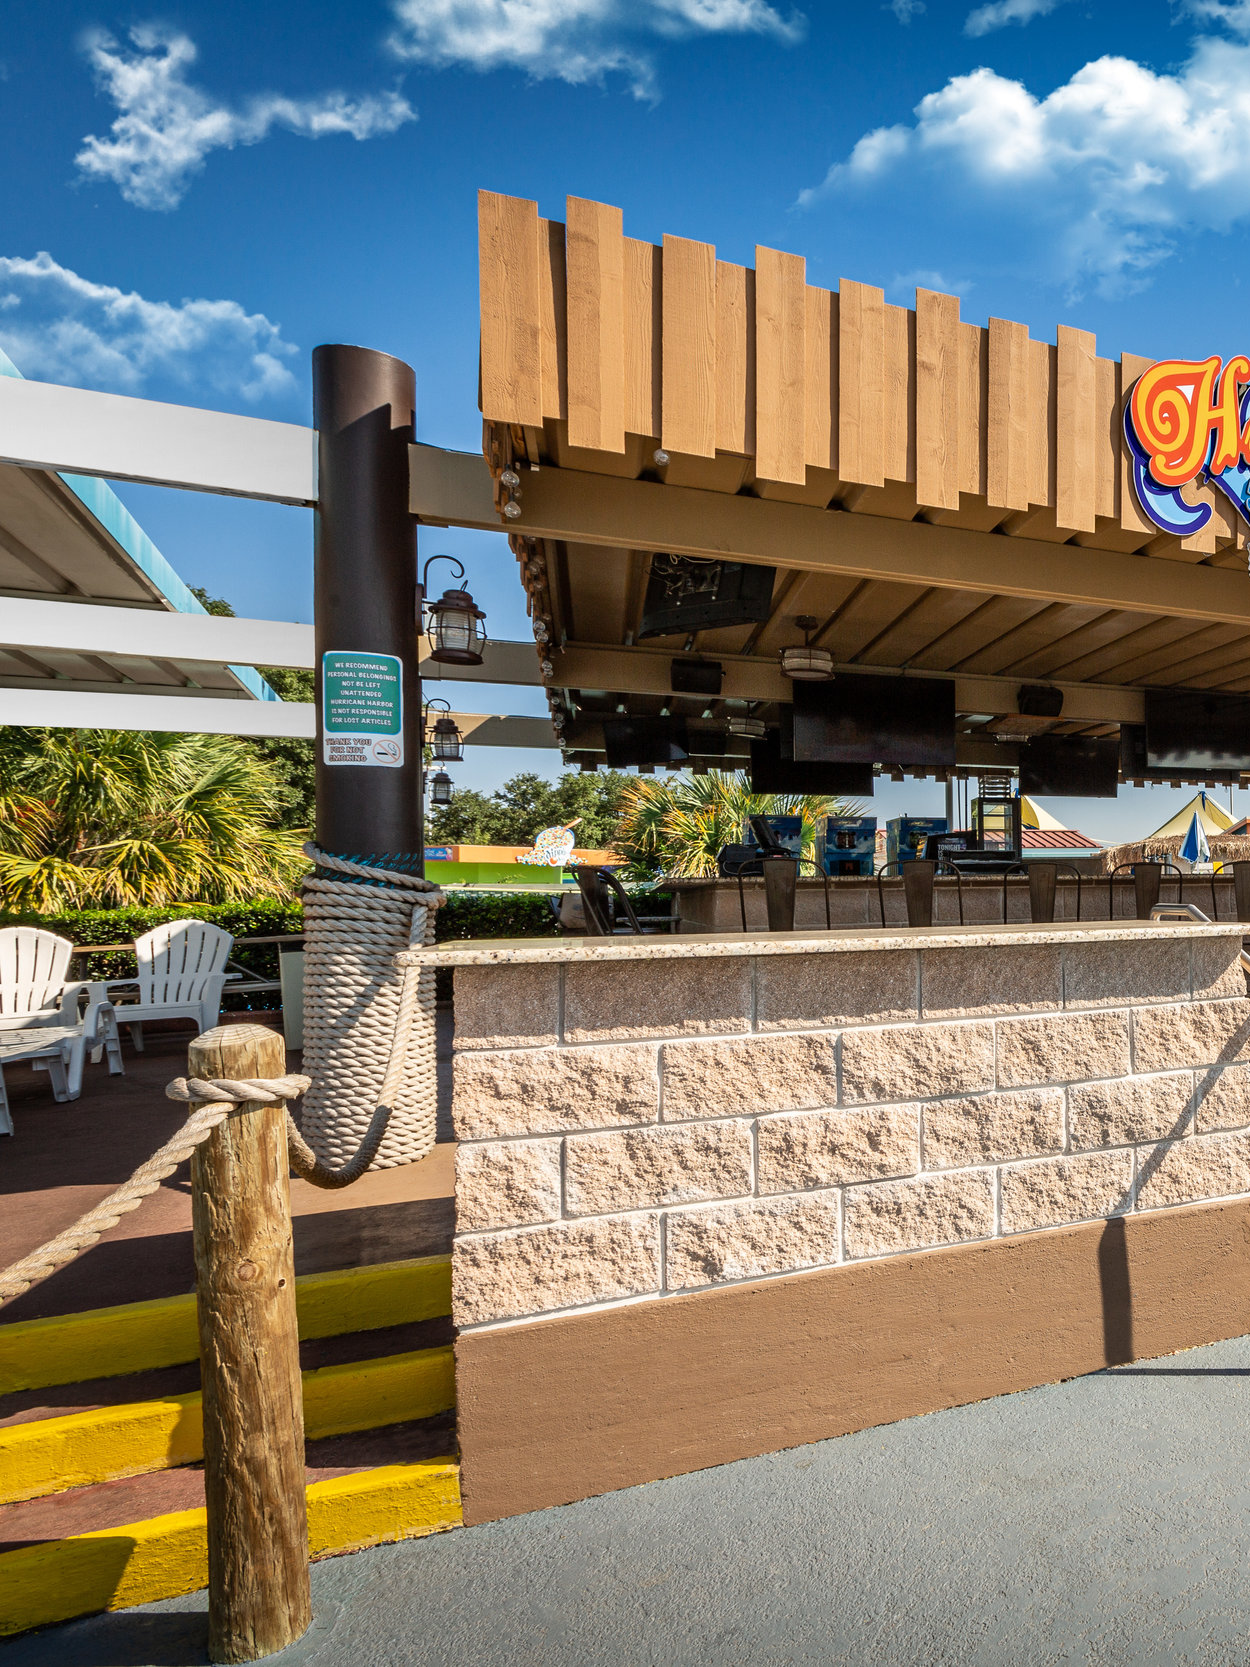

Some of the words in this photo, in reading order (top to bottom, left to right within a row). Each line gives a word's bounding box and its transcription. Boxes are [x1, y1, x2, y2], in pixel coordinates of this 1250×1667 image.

[345, 662, 388, 671] RECOMMEND
[359, 672, 397, 681] BELONGINGS
[340, 690, 382, 698] UNATTENDED
[367, 700, 394, 708] HARBOR
[351, 709, 393, 717] RESPONSIBLE
[361, 718, 391, 726] ARTICLES
[325, 738, 351, 746] THANK
[353, 738, 372, 746] YOU
[330, 746, 345, 754] FOR
[346, 746, 365, 754] NOT
